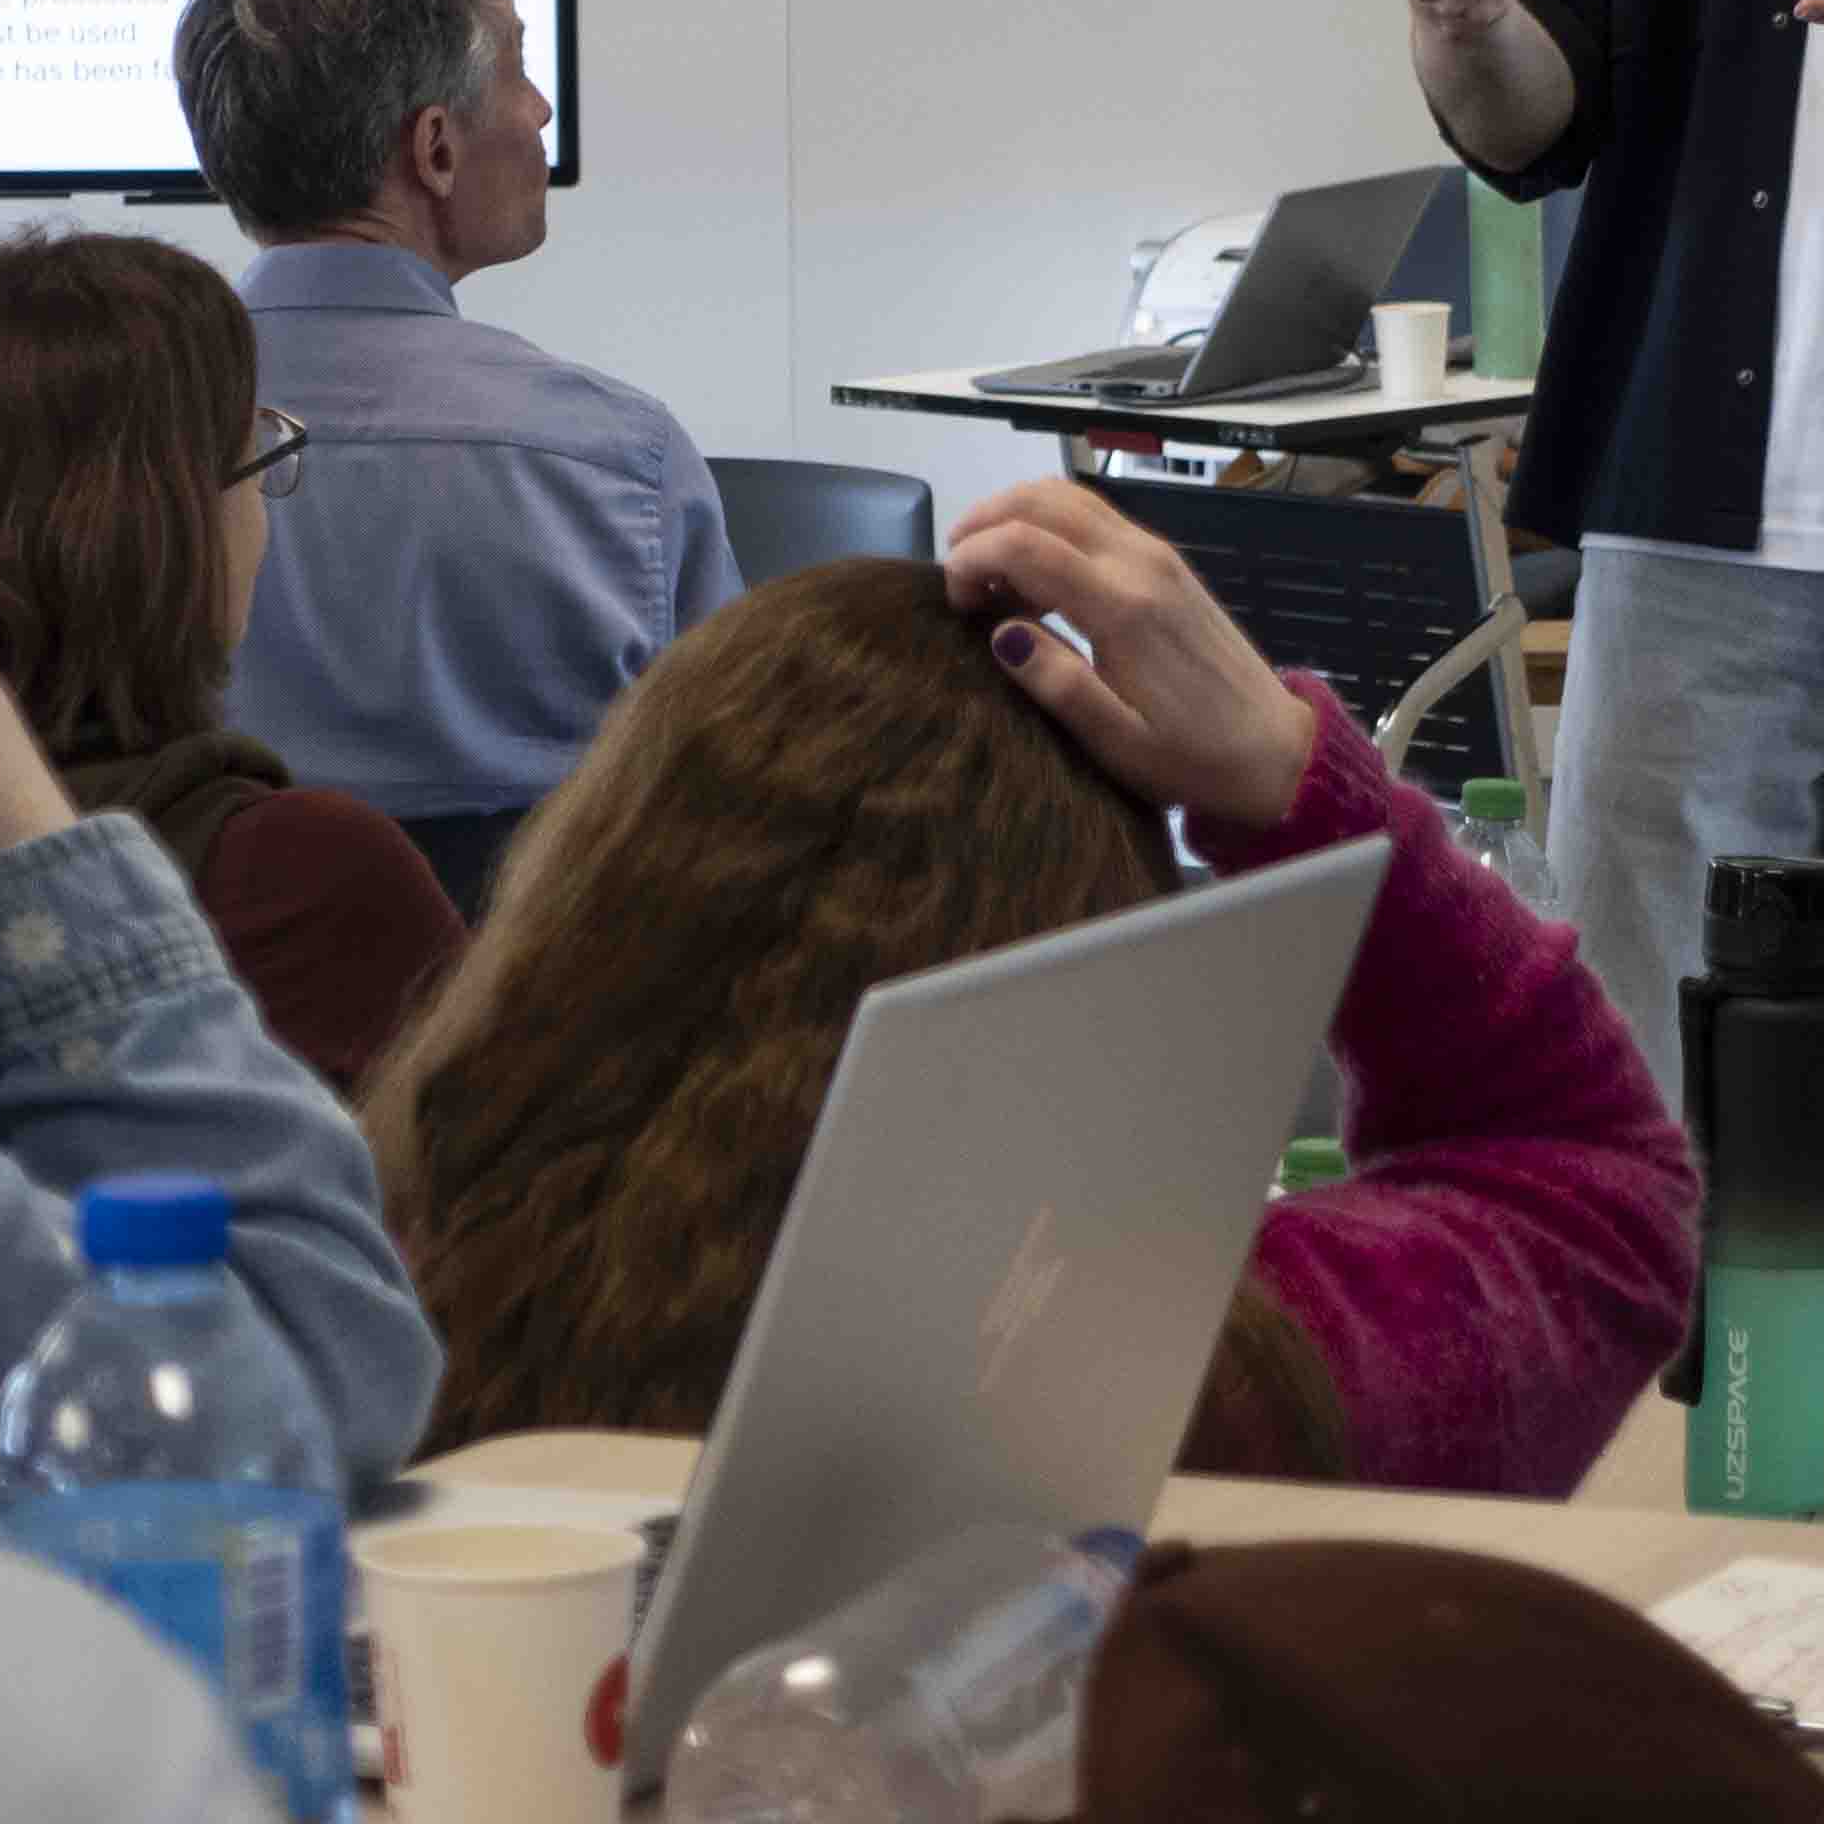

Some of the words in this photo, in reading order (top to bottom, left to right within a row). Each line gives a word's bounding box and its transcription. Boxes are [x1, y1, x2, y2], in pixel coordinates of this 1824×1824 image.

[24, 21, 62, 45] be
[70, 20, 137, 45] used
[14, 57, 63, 83] has
[73, 56, 143, 82] been
[1726, 1327, 1751, 1501] UZSPACE
